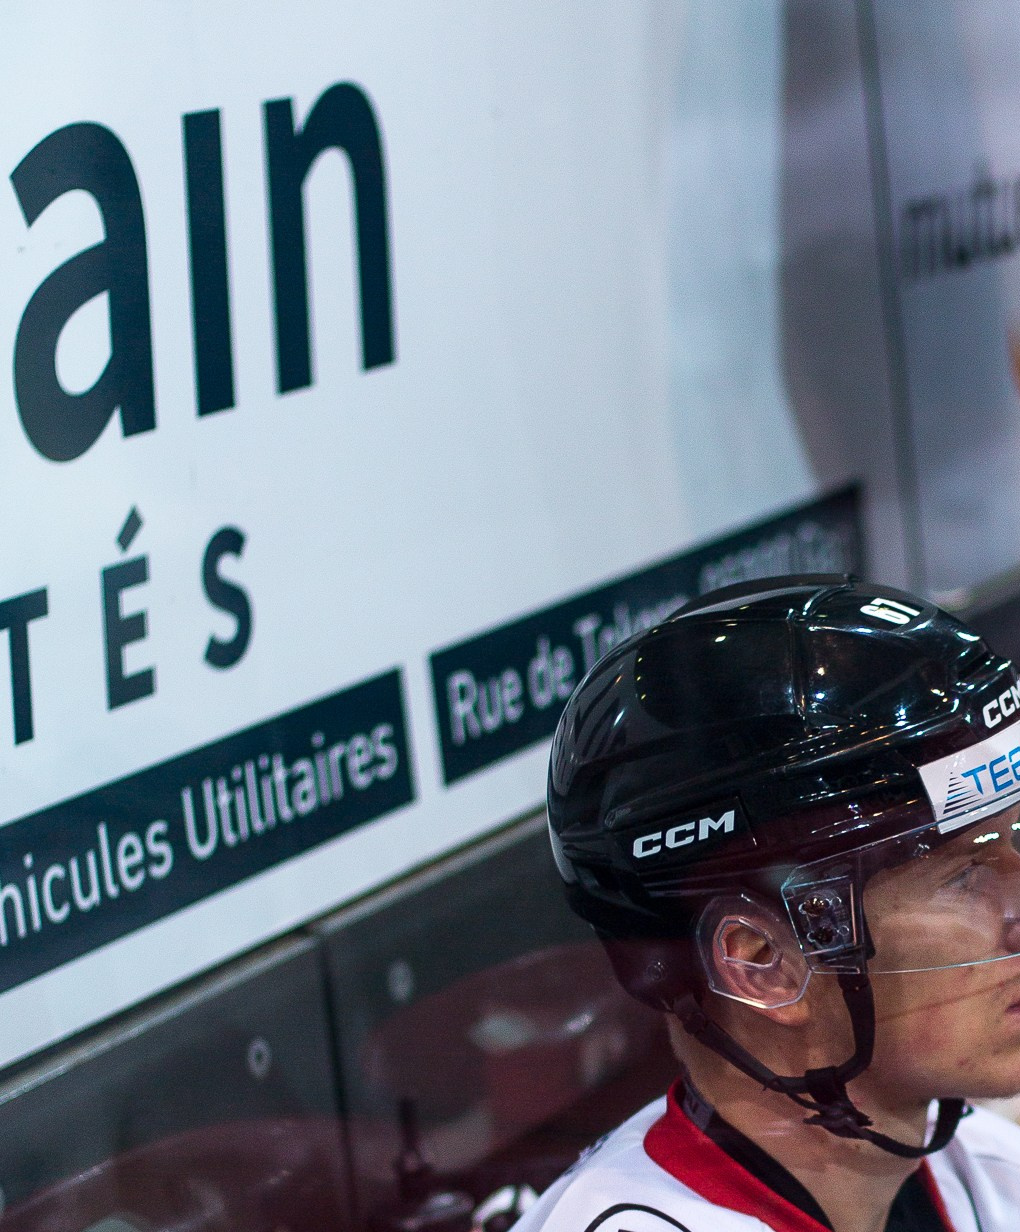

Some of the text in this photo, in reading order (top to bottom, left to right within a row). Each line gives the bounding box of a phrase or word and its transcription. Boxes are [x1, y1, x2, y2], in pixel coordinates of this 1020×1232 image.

[446, 667, 525, 746] Rue
[527, 633, 576, 711] de
[181, 724, 400, 860] Utilitaires
[632, 809, 735, 859] CCM
